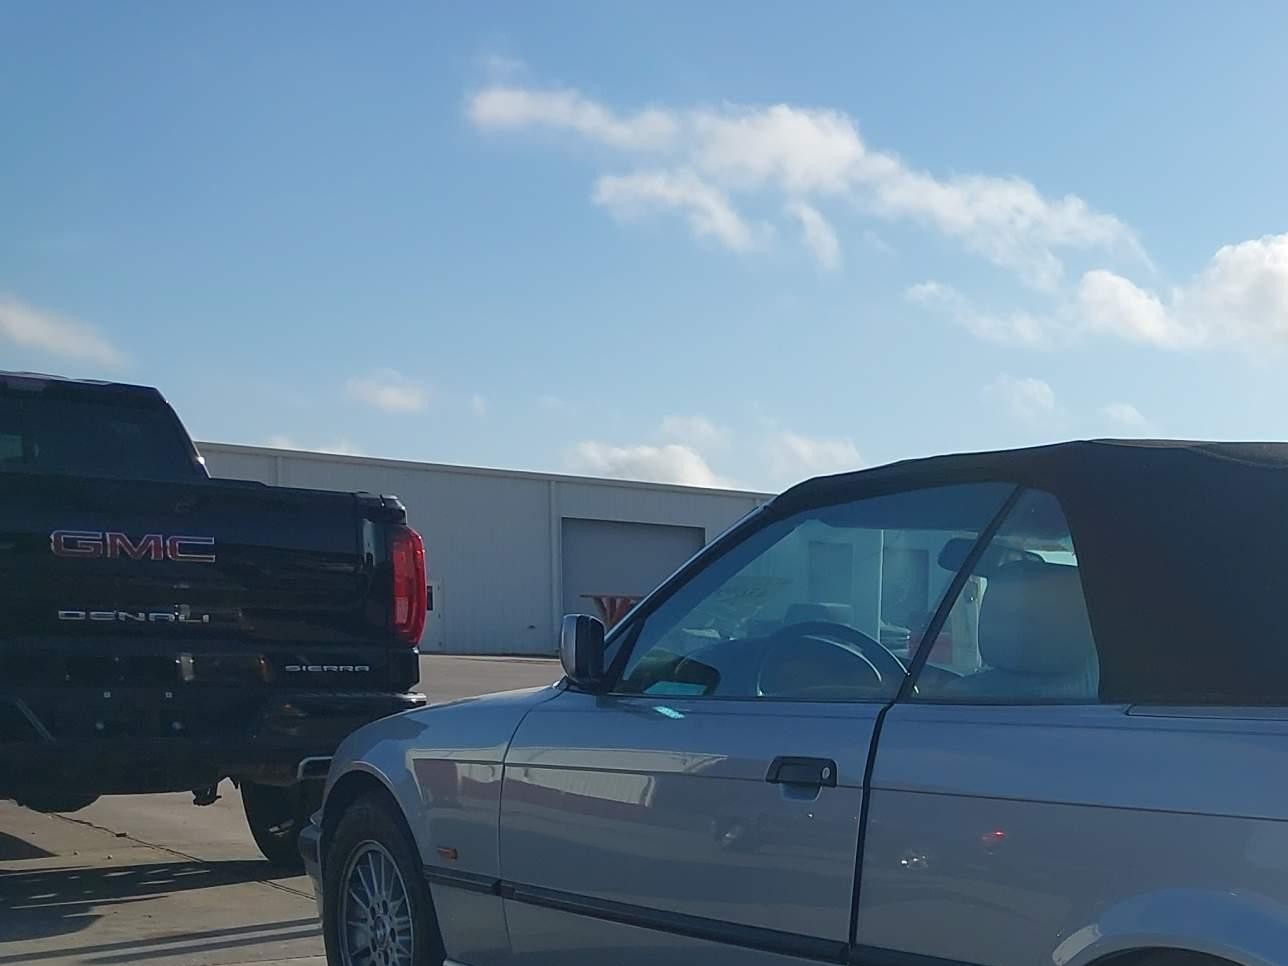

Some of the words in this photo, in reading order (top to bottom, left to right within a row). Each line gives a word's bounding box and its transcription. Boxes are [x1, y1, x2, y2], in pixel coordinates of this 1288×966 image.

[49, 529, 216, 563] GMC
[57, 609, 210, 624] DENALI
[284, 664, 370, 673] SIERRA
